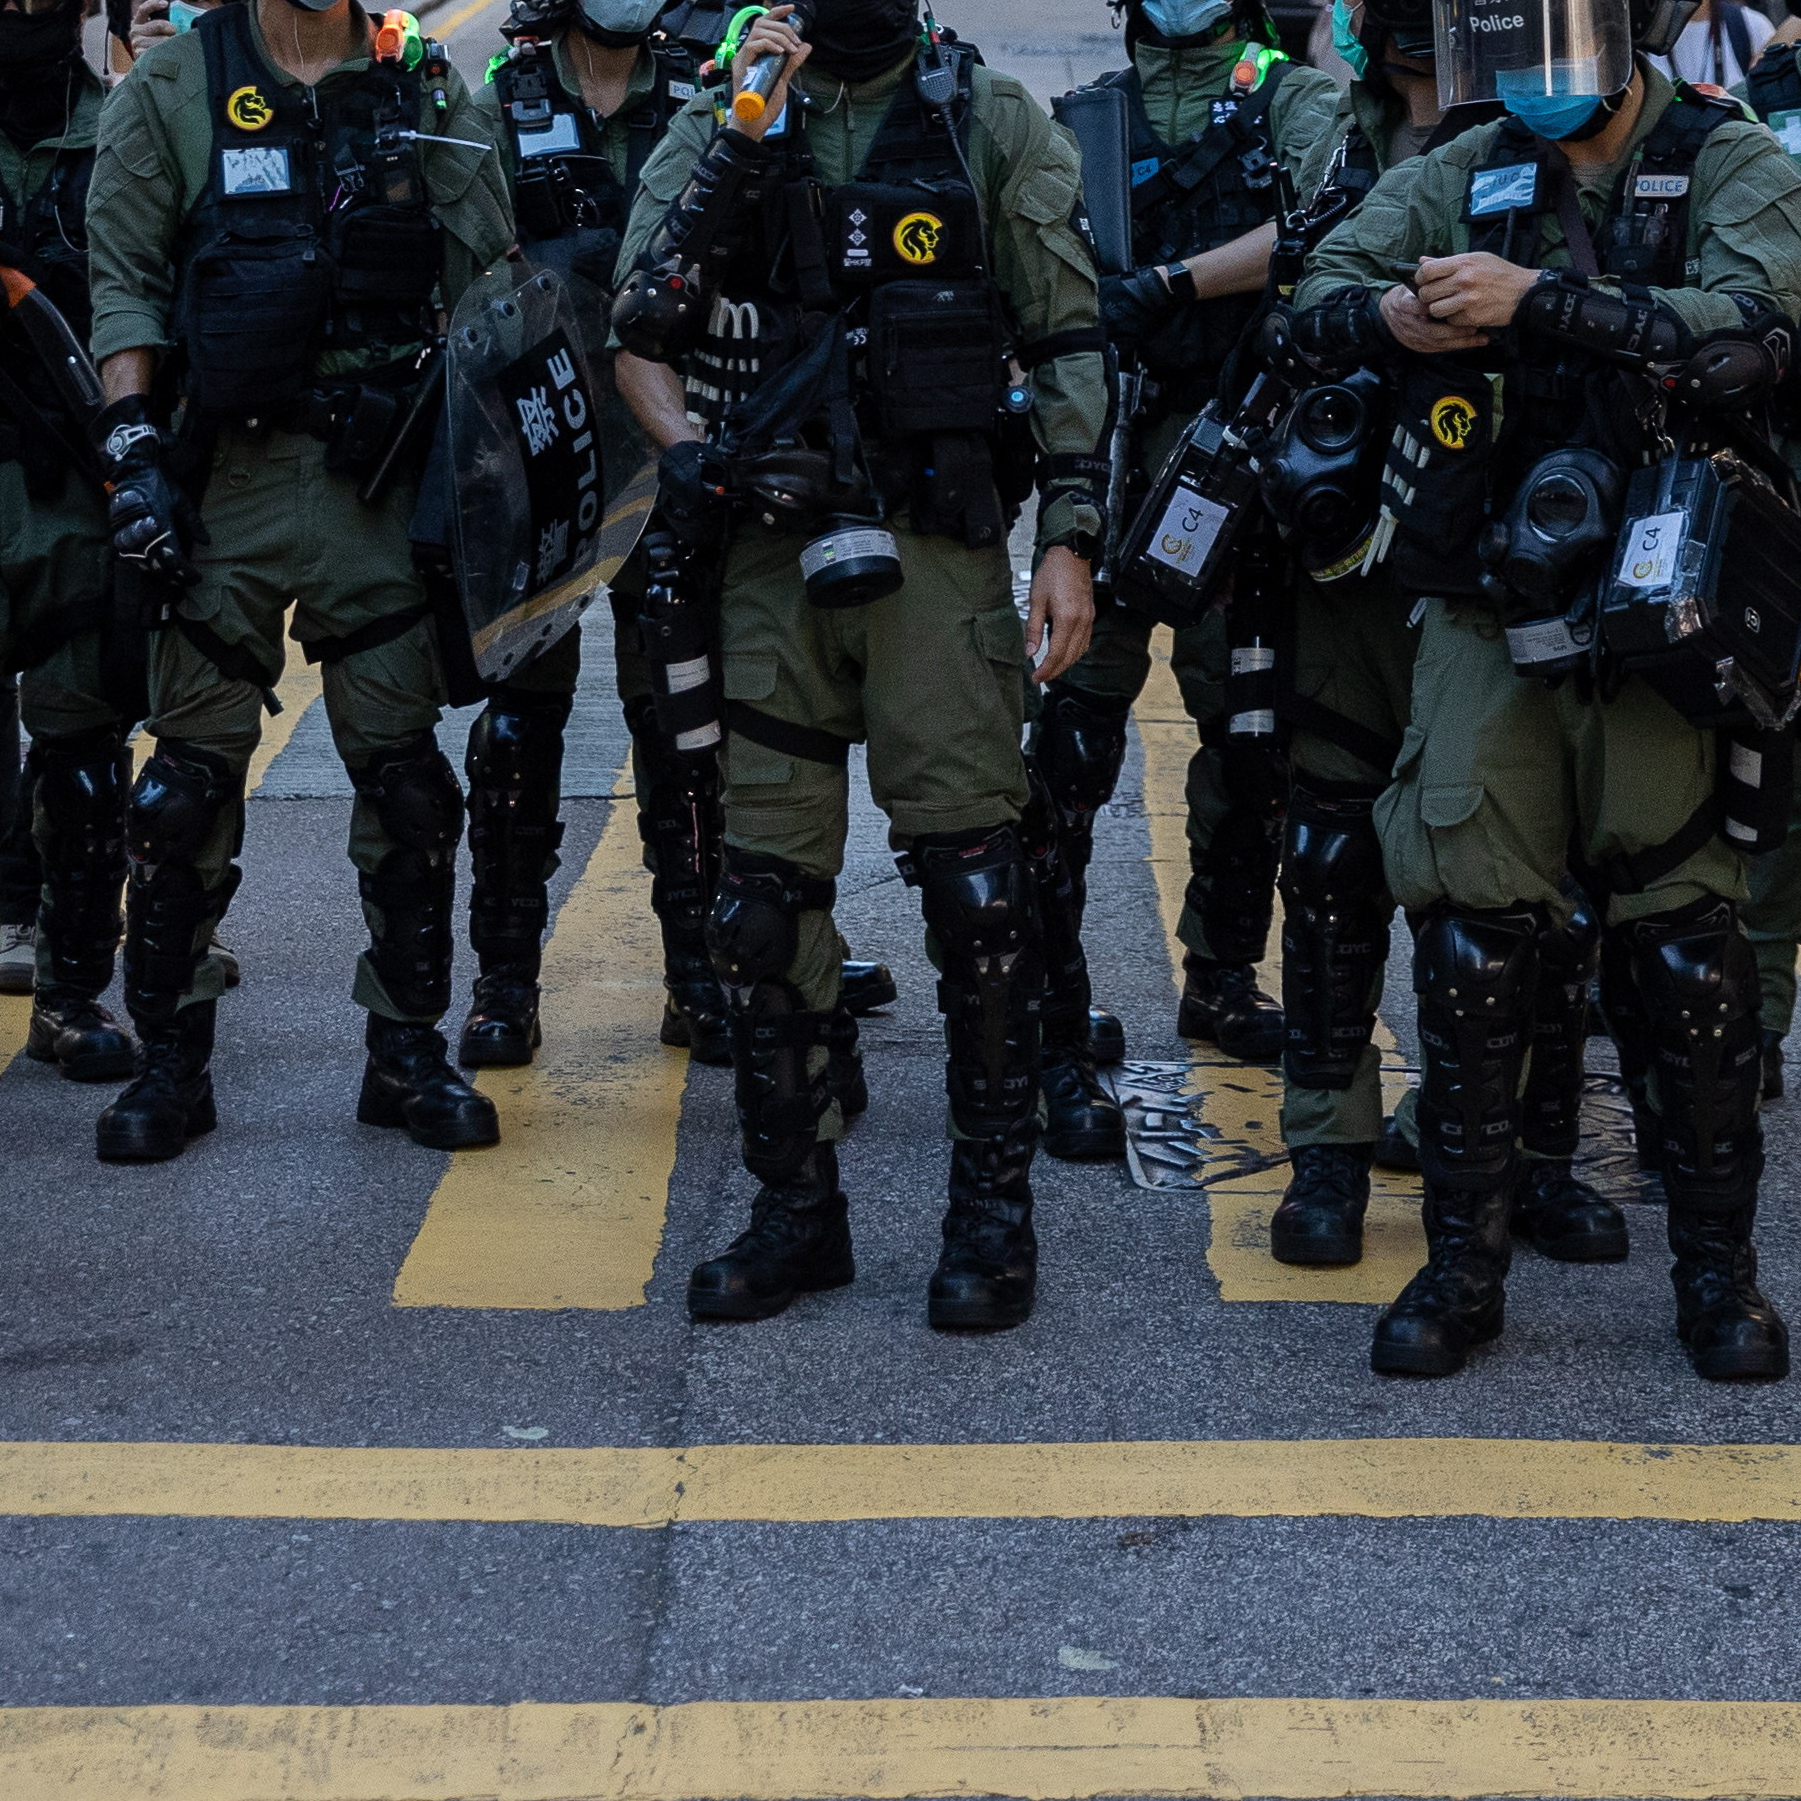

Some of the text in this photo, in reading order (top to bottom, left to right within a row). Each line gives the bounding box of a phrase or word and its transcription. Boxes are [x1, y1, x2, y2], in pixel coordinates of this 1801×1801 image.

[1469, 12, 1525, 33] Police
[1181, 506, 1206, 534] C4
[1641, 526, 1663, 552] C4
